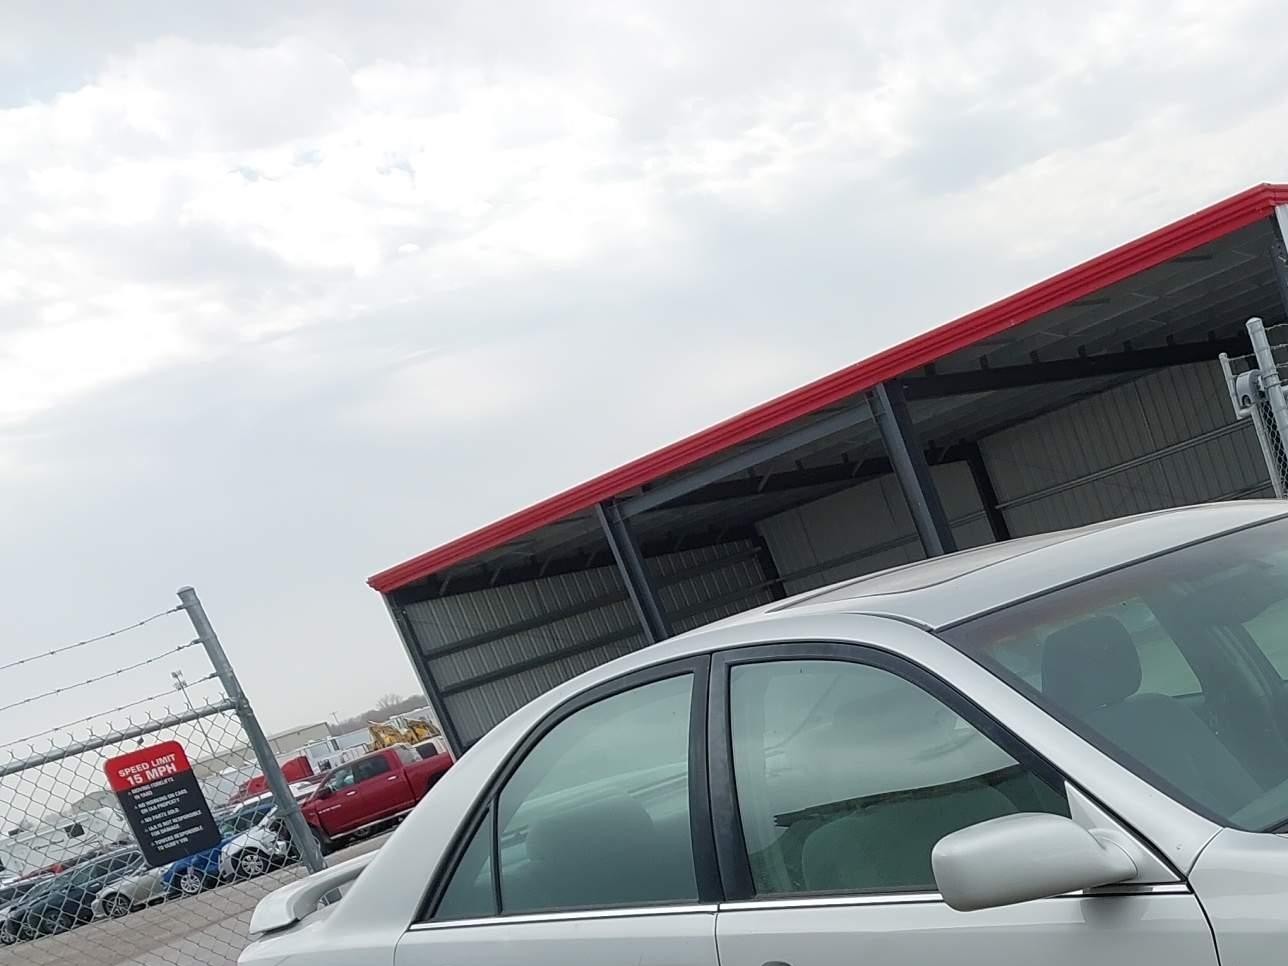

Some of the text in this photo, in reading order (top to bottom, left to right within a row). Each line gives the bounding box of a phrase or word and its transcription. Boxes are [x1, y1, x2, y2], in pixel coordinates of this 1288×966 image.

[118, 753, 176, 777] SPEED LIMIT
[127, 763, 177, 786] 15 MPH
[172, 810, 202, 823] RESPONSIBLE
